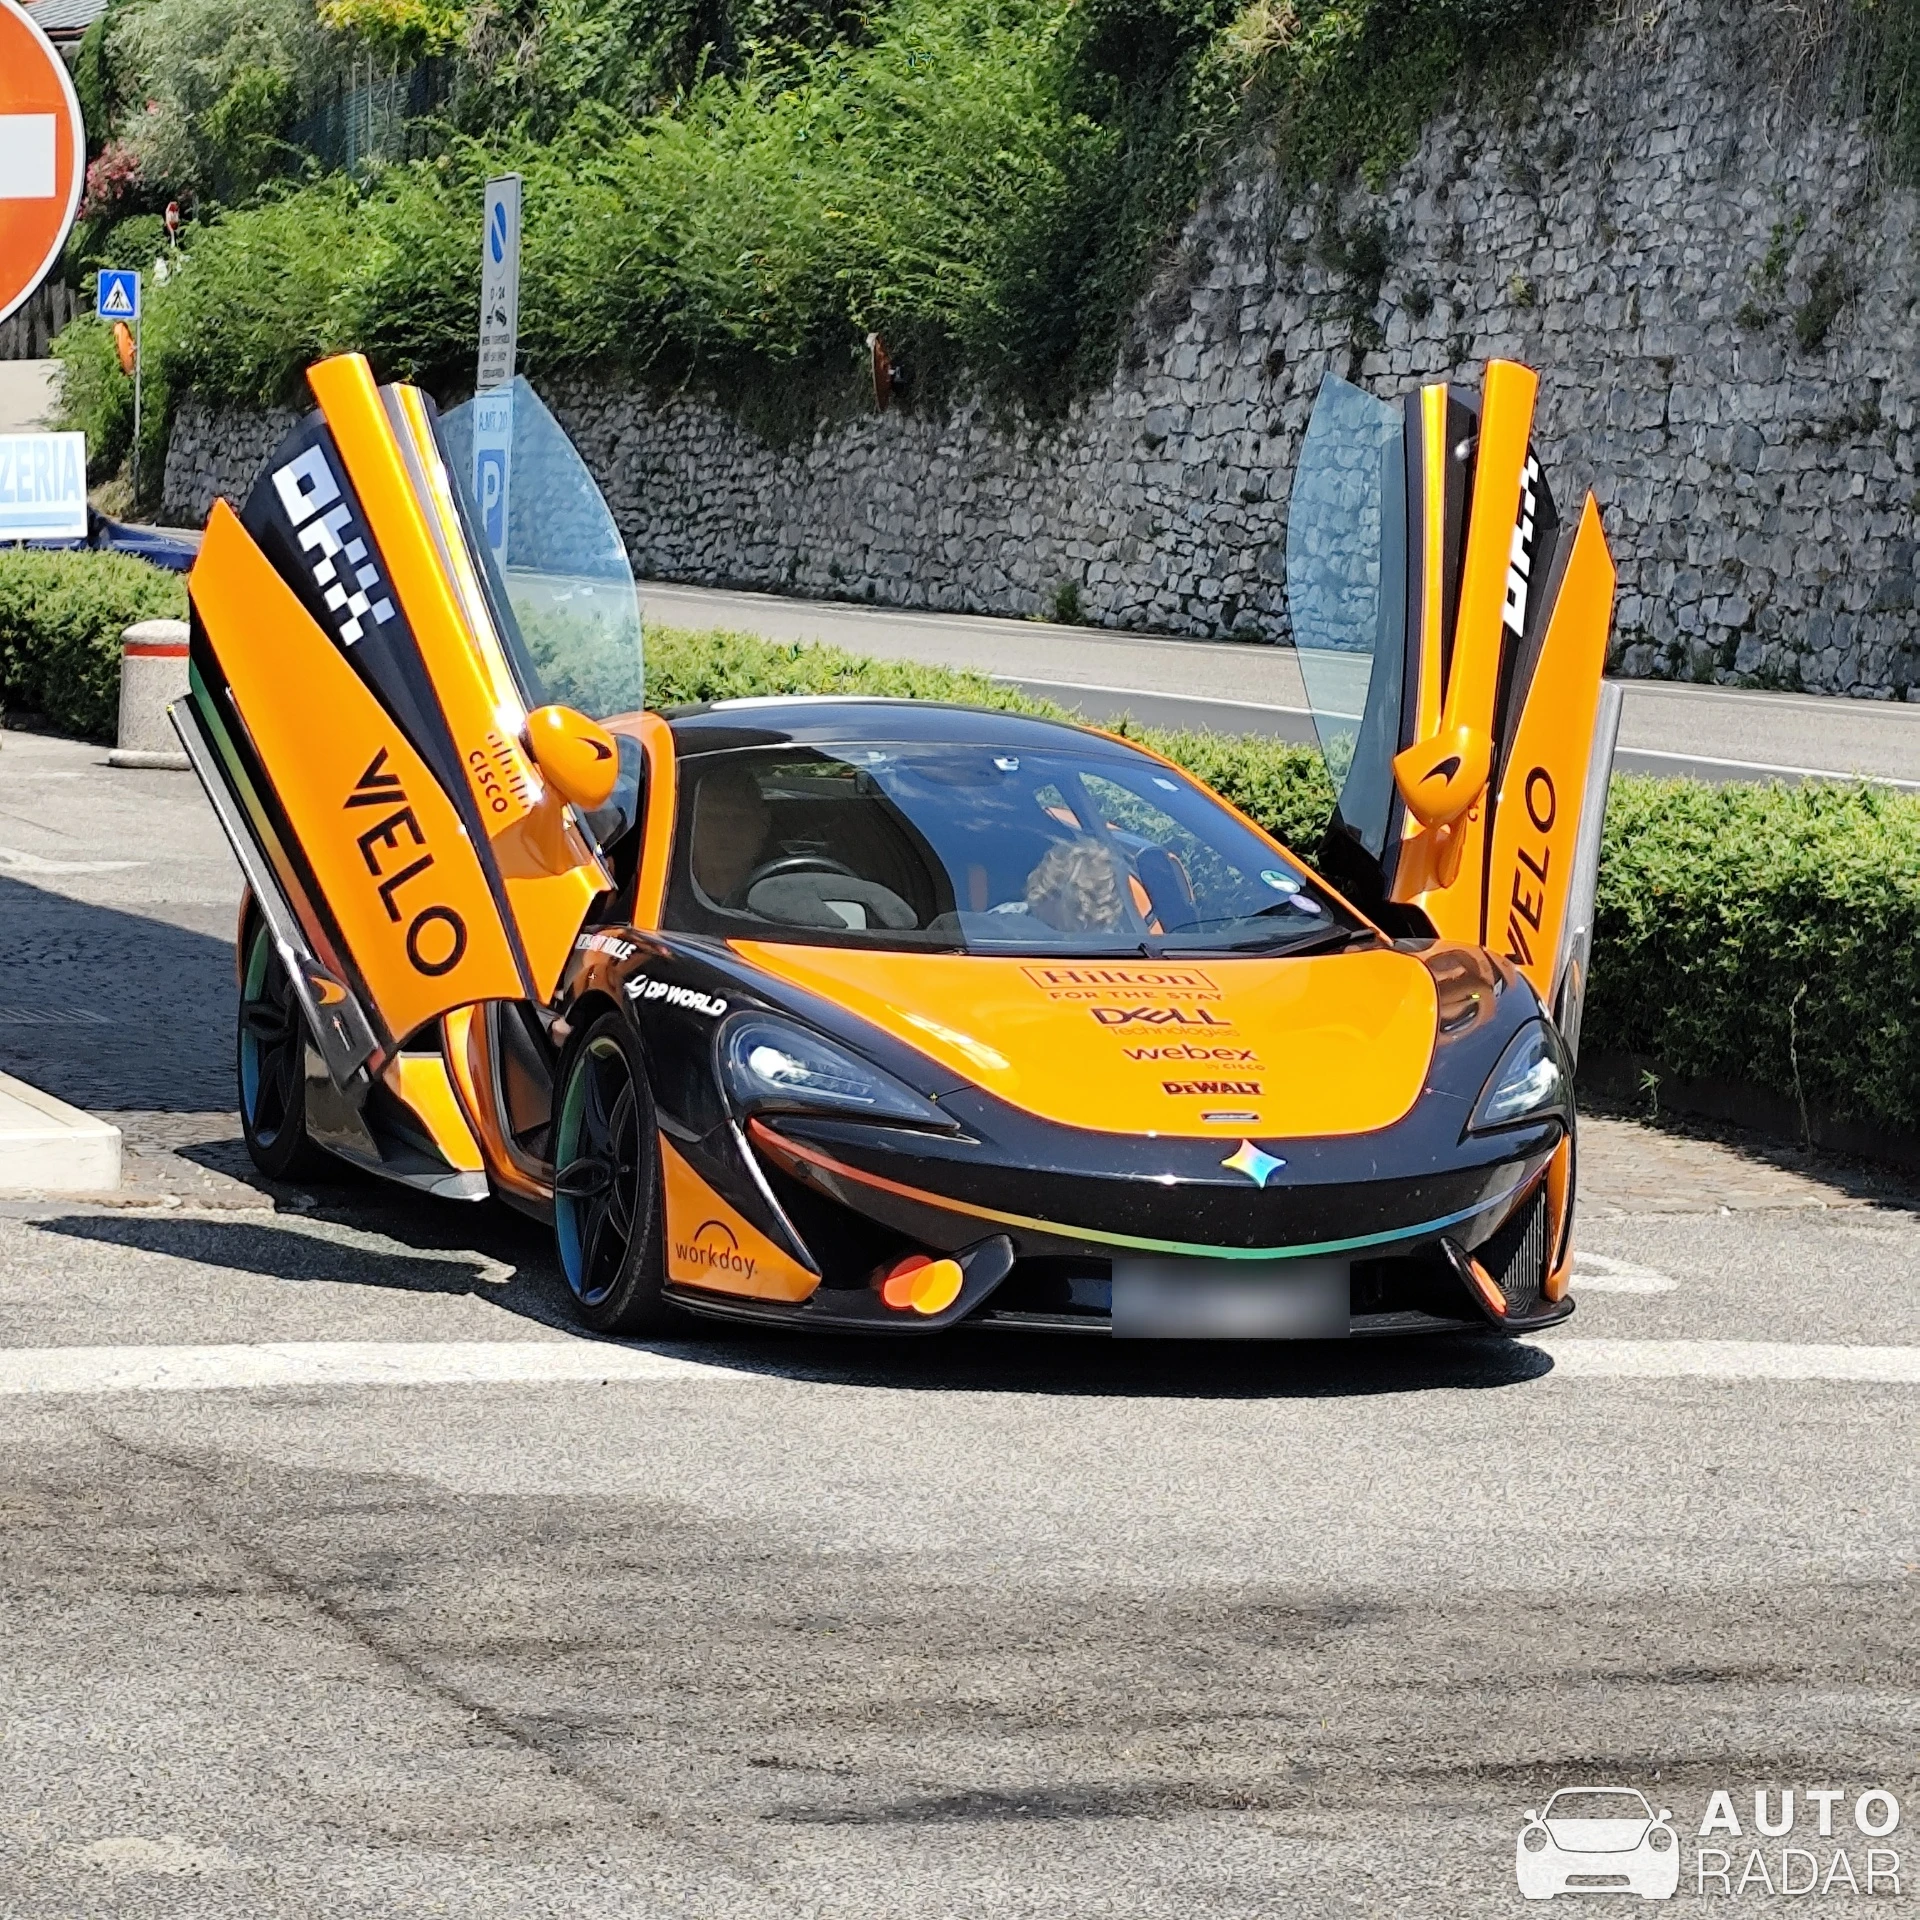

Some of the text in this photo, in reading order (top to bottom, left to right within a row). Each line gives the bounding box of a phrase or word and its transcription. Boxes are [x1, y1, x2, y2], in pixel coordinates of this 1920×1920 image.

[469, 750, 508, 813] CISCO
[343, 746, 467, 976] VELO
[1504, 766, 1556, 967] VELO
[1041, 970, 1198, 986] Hilton
[644, 981, 728, 1017] DP WORLD
[1050, 991, 1222, 1001] FOR THE STAY
[1091, 1007, 1232, 1026] DELL
[1109, 1026, 1241, 1038] Technologies
[1123, 1044, 1259, 1061] webex
